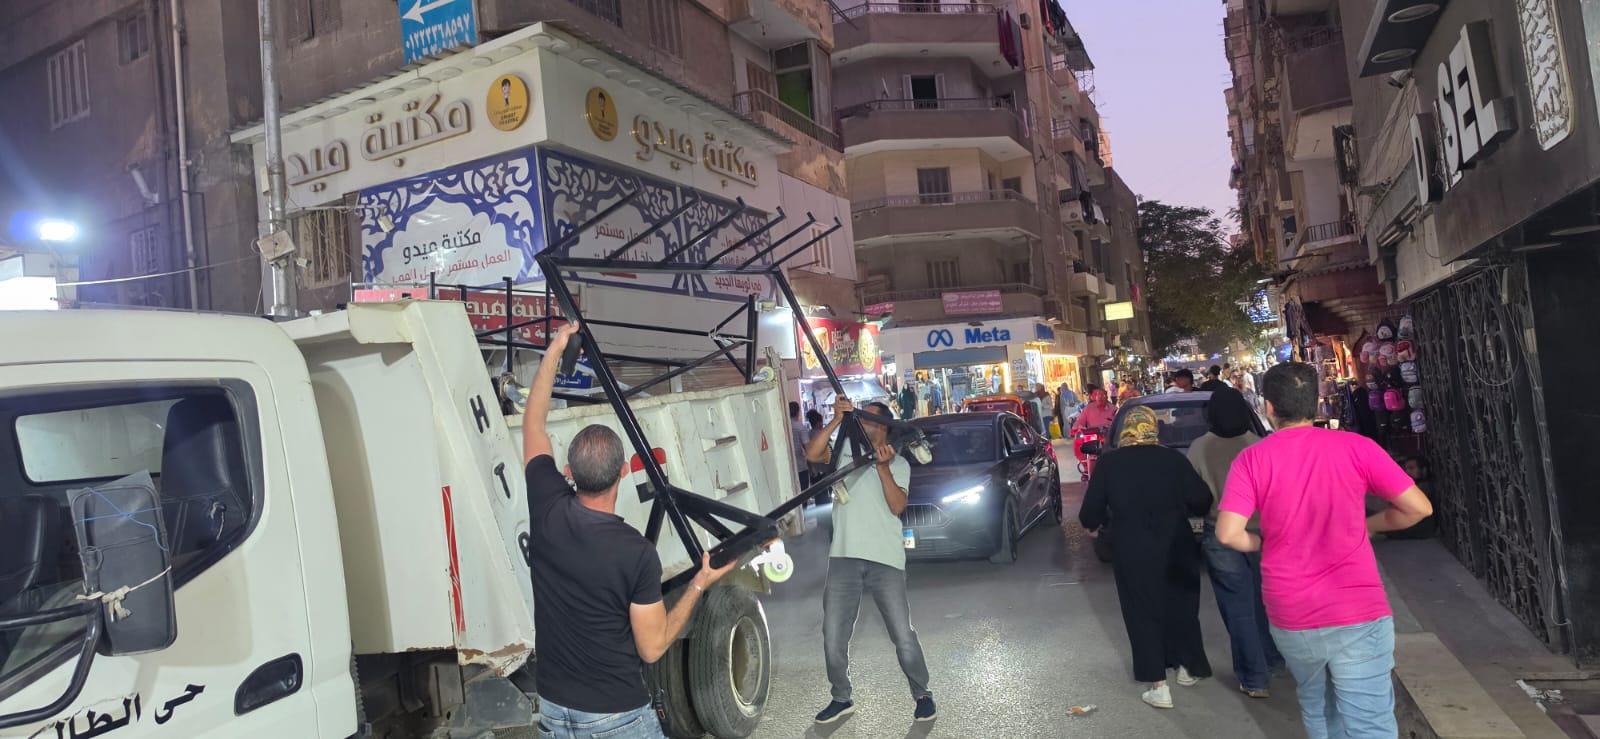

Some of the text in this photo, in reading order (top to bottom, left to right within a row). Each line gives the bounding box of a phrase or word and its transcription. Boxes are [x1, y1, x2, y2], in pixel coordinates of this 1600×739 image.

[286, 94, 472, 192] مكتبة ميد
[633, 114, 759, 188] مكتبة ميدو
[595, 222, 625, 239] مستمر
[403, 228, 481, 264] مكتبة ميدو
[481, 250, 511, 269] العمل
[449, 258, 479, 275] مستمر
[964, 327, 1011, 344] Meta
[55, 693, 141, 739] الطال
